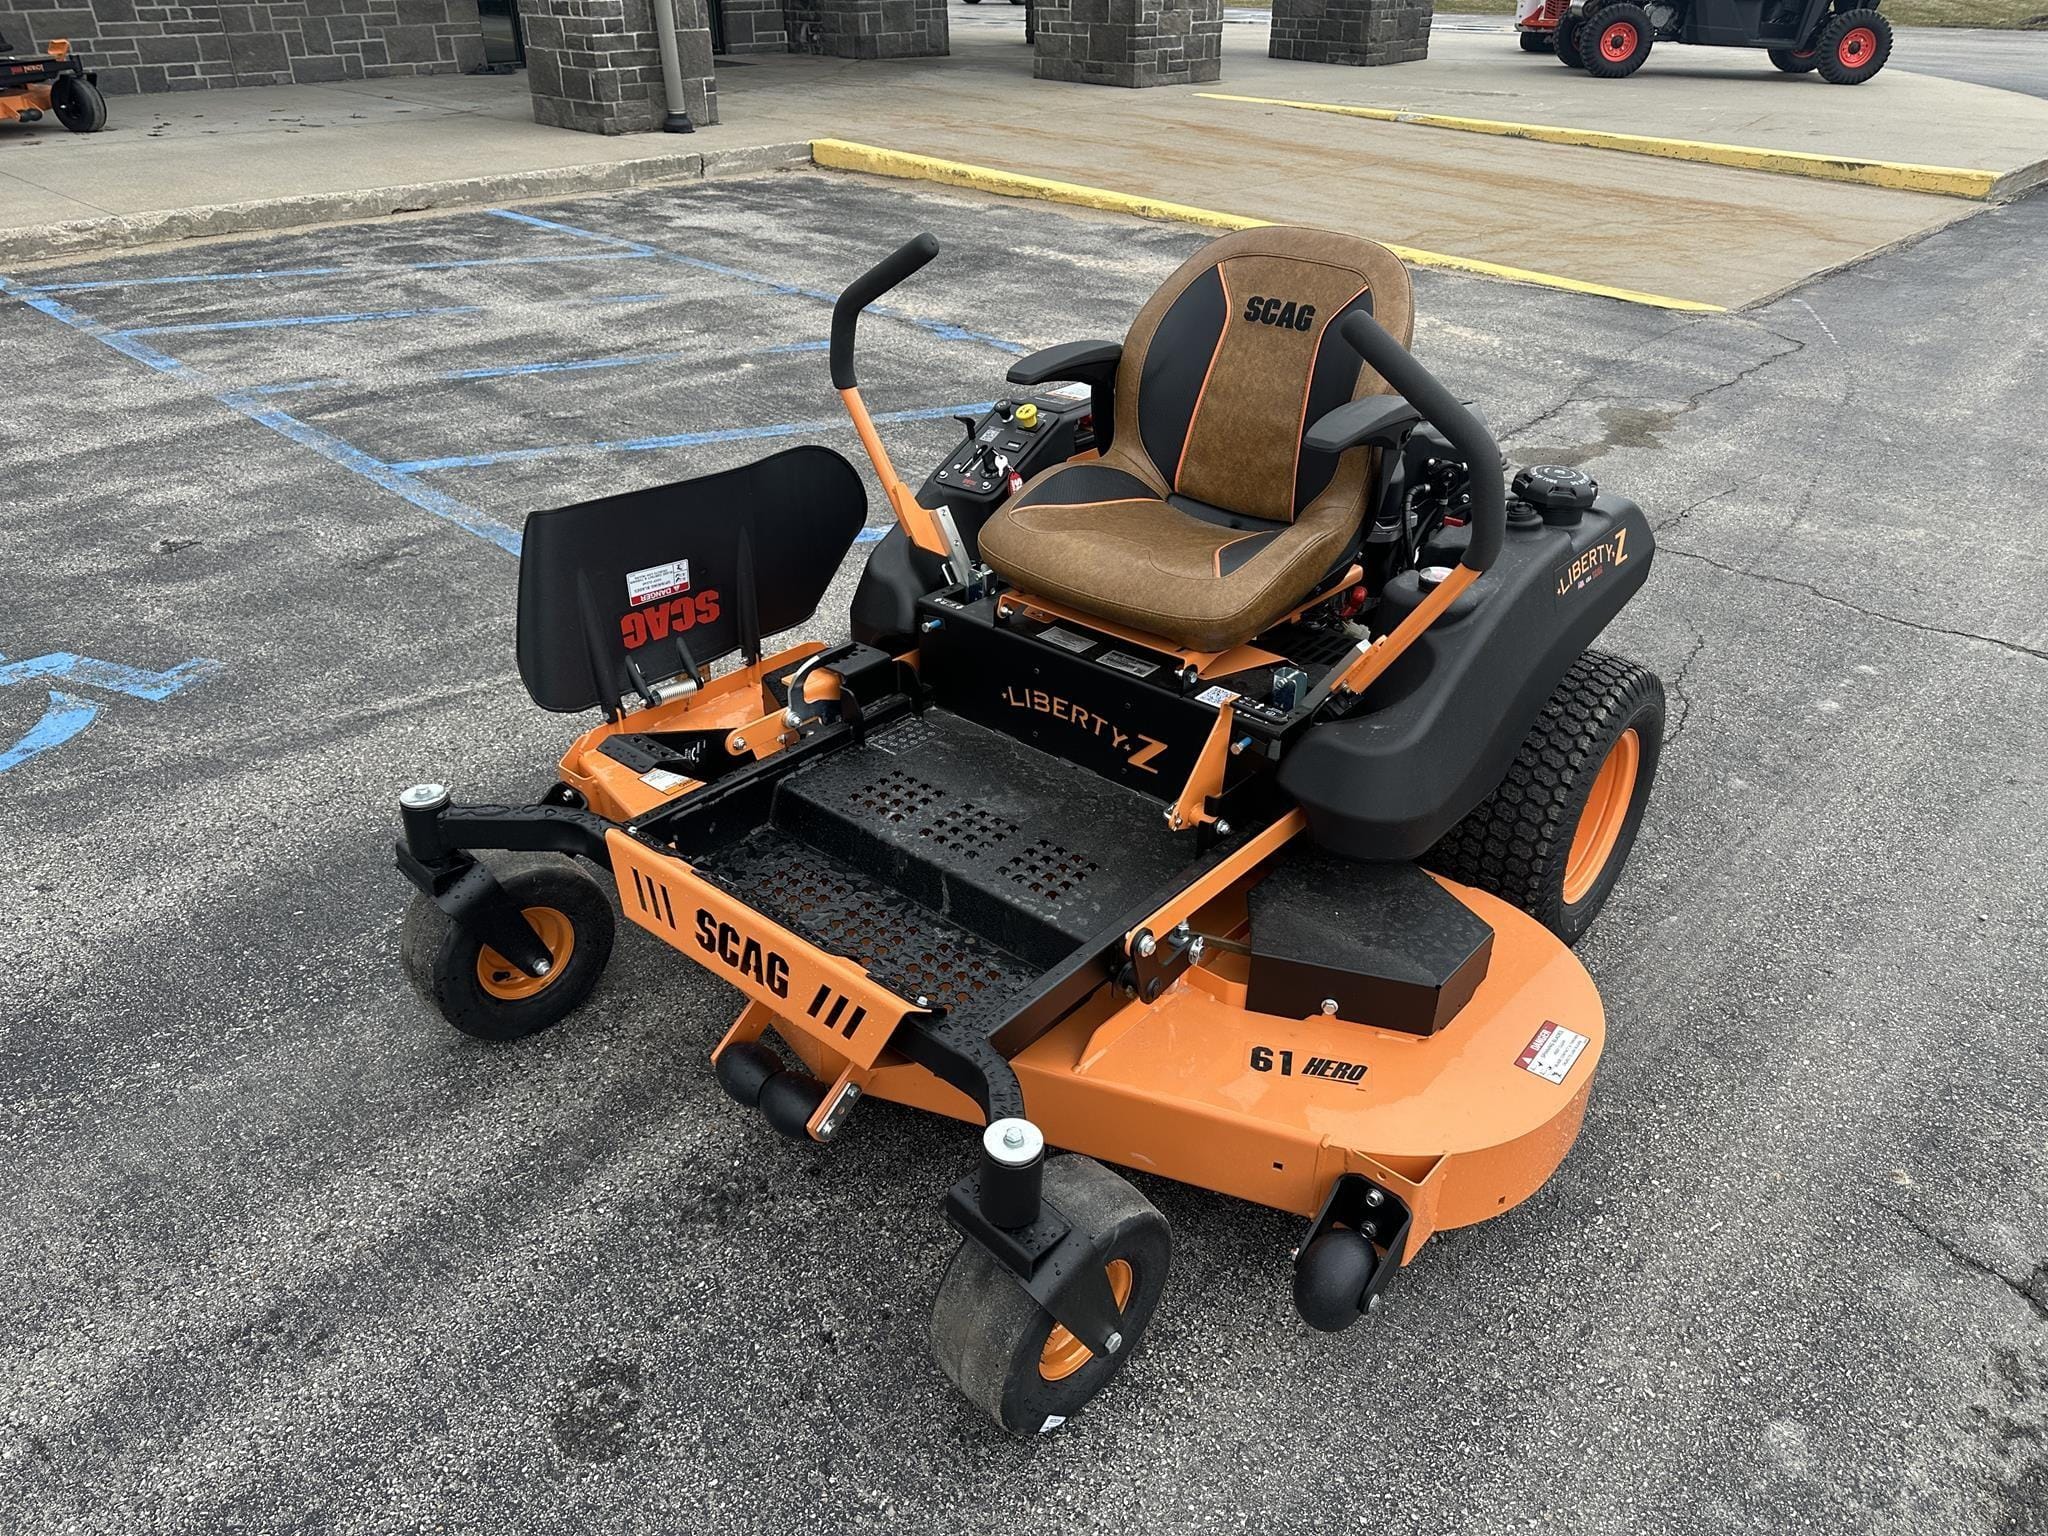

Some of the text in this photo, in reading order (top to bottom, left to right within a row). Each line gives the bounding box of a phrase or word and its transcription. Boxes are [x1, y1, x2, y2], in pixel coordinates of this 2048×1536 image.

[1243, 295, 1316, 332] SCAG
[1560, 528, 1628, 595] LIBERTY Z
[621, 589, 720, 650] SCAG
[640, 588, 672, 603] DANGER
[1008, 686, 1168, 775] LIBERTY Z
[695, 908, 789, 999] SCAG
[1250, 1046, 1368, 1082] 61 HERO
